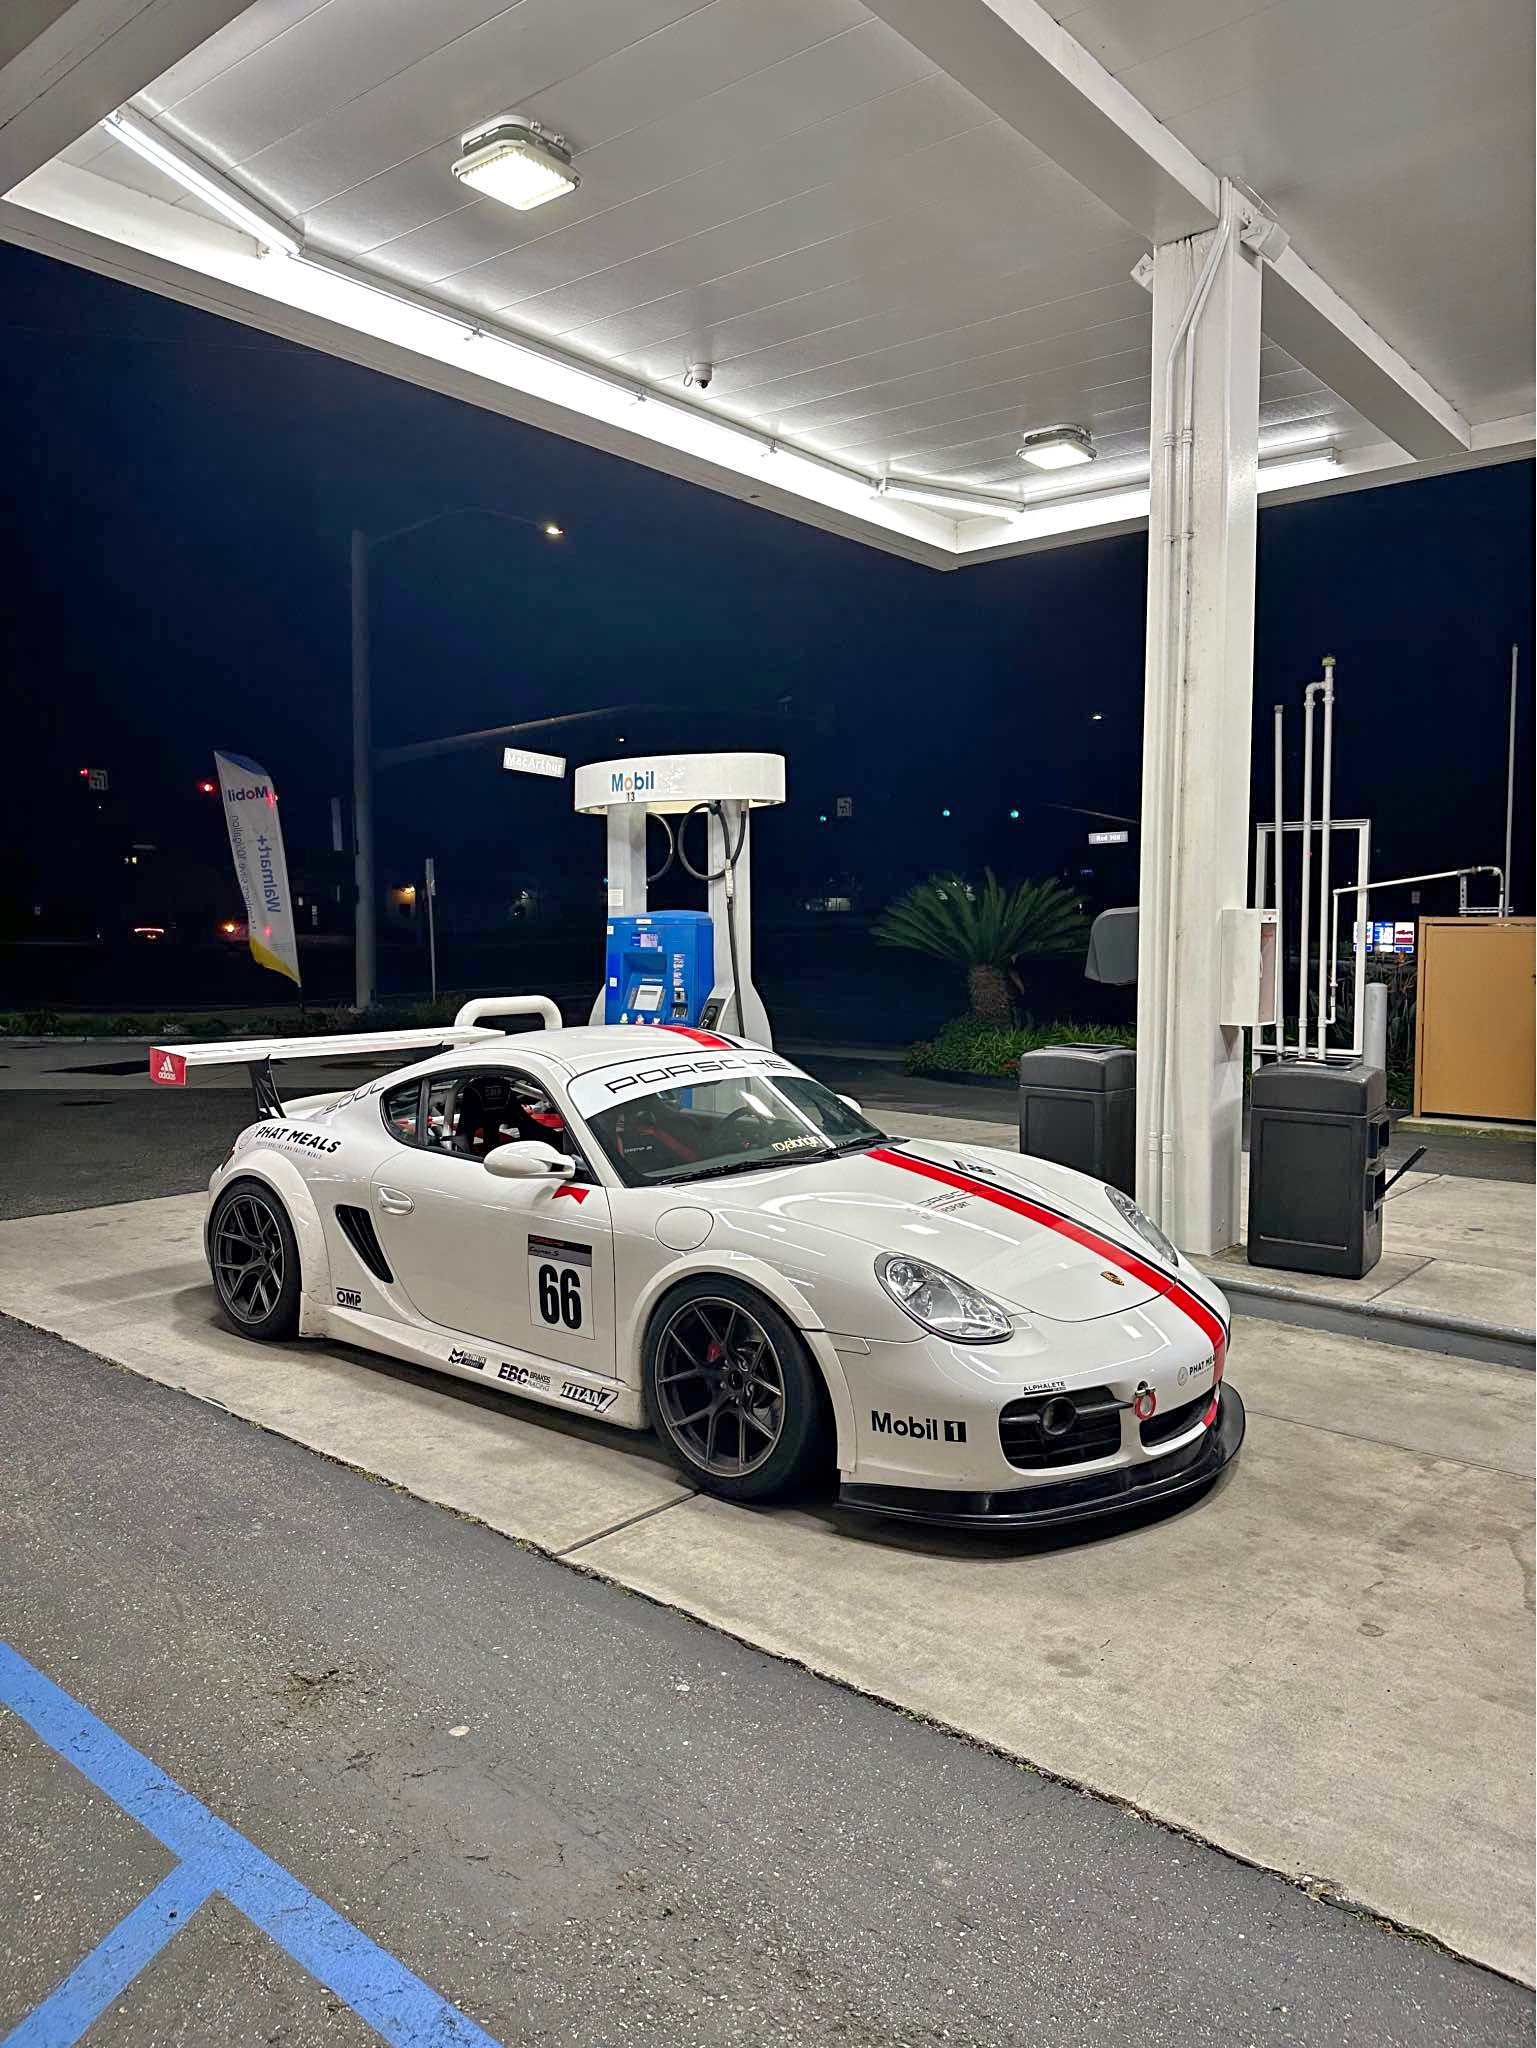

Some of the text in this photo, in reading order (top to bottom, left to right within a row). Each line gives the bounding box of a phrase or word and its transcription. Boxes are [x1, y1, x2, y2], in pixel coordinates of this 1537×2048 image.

[506, 752, 563, 775] MacArthur
[611, 771, 655, 793] Mobil
[627, 792, 636, 801] 13
[158, 1071, 176, 1080] adidas
[605, 1059, 791, 1093] PORSCHE
[321, 1083, 385, 1116] SOUL
[255, 1126, 289, 1140] PHAT
[286, 1130, 341, 1153] MEALS
[336, 1291, 362, 1307] OMP
[538, 1264, 582, 1330] 66
[497, 1362, 529, 1385] EBC
[530, 1371, 551, 1384] BRAKES
[1189, 1360, 1205, 1376] PHAT
[1023, 1380, 1066, 1392] ALPHALETE
[871, 1409, 938, 1441] Mobil
